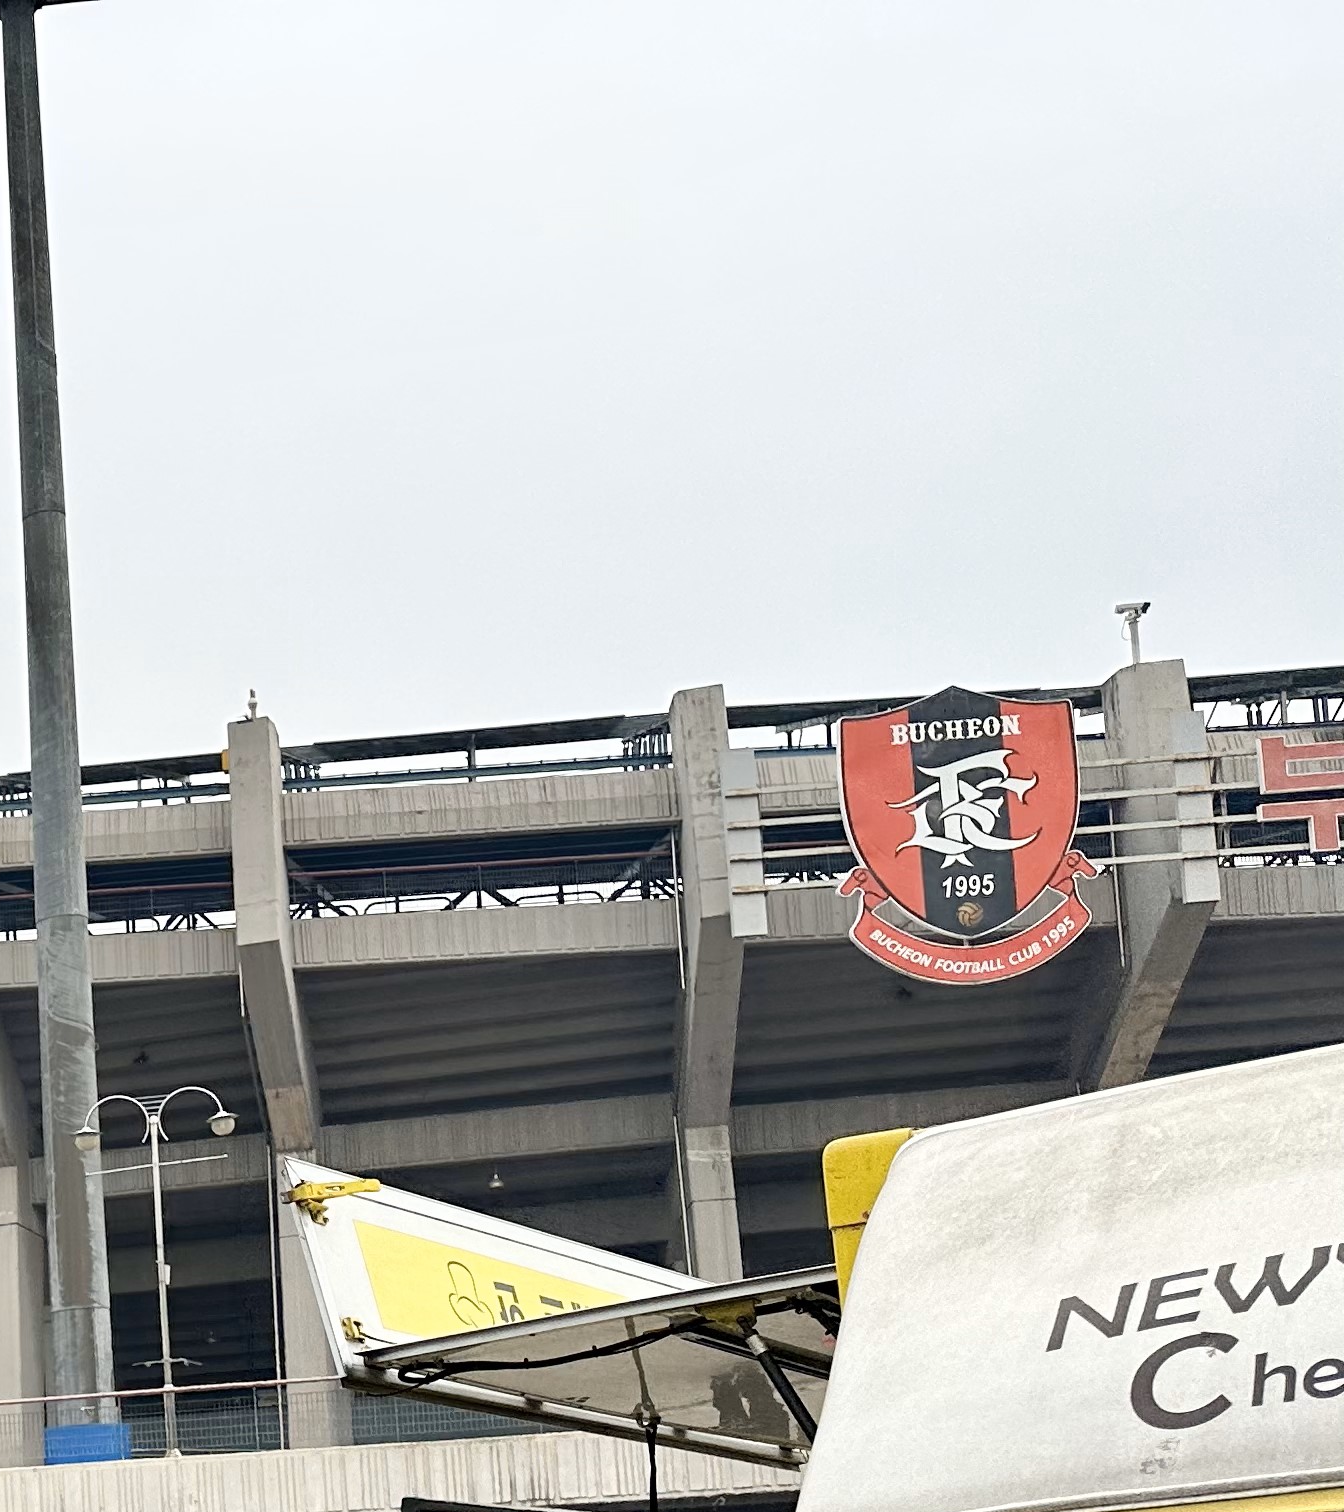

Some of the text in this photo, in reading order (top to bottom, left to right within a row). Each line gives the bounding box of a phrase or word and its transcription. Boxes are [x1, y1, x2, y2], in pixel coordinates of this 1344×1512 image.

[889, 714, 1022, 746] BUCHEON
[941, 873, 996, 899] 1995
[869, 915, 1076, 975] BUCHEON FOOTBALL CLUB 1995
[1046, 1243, 1344, 1352] NEW
